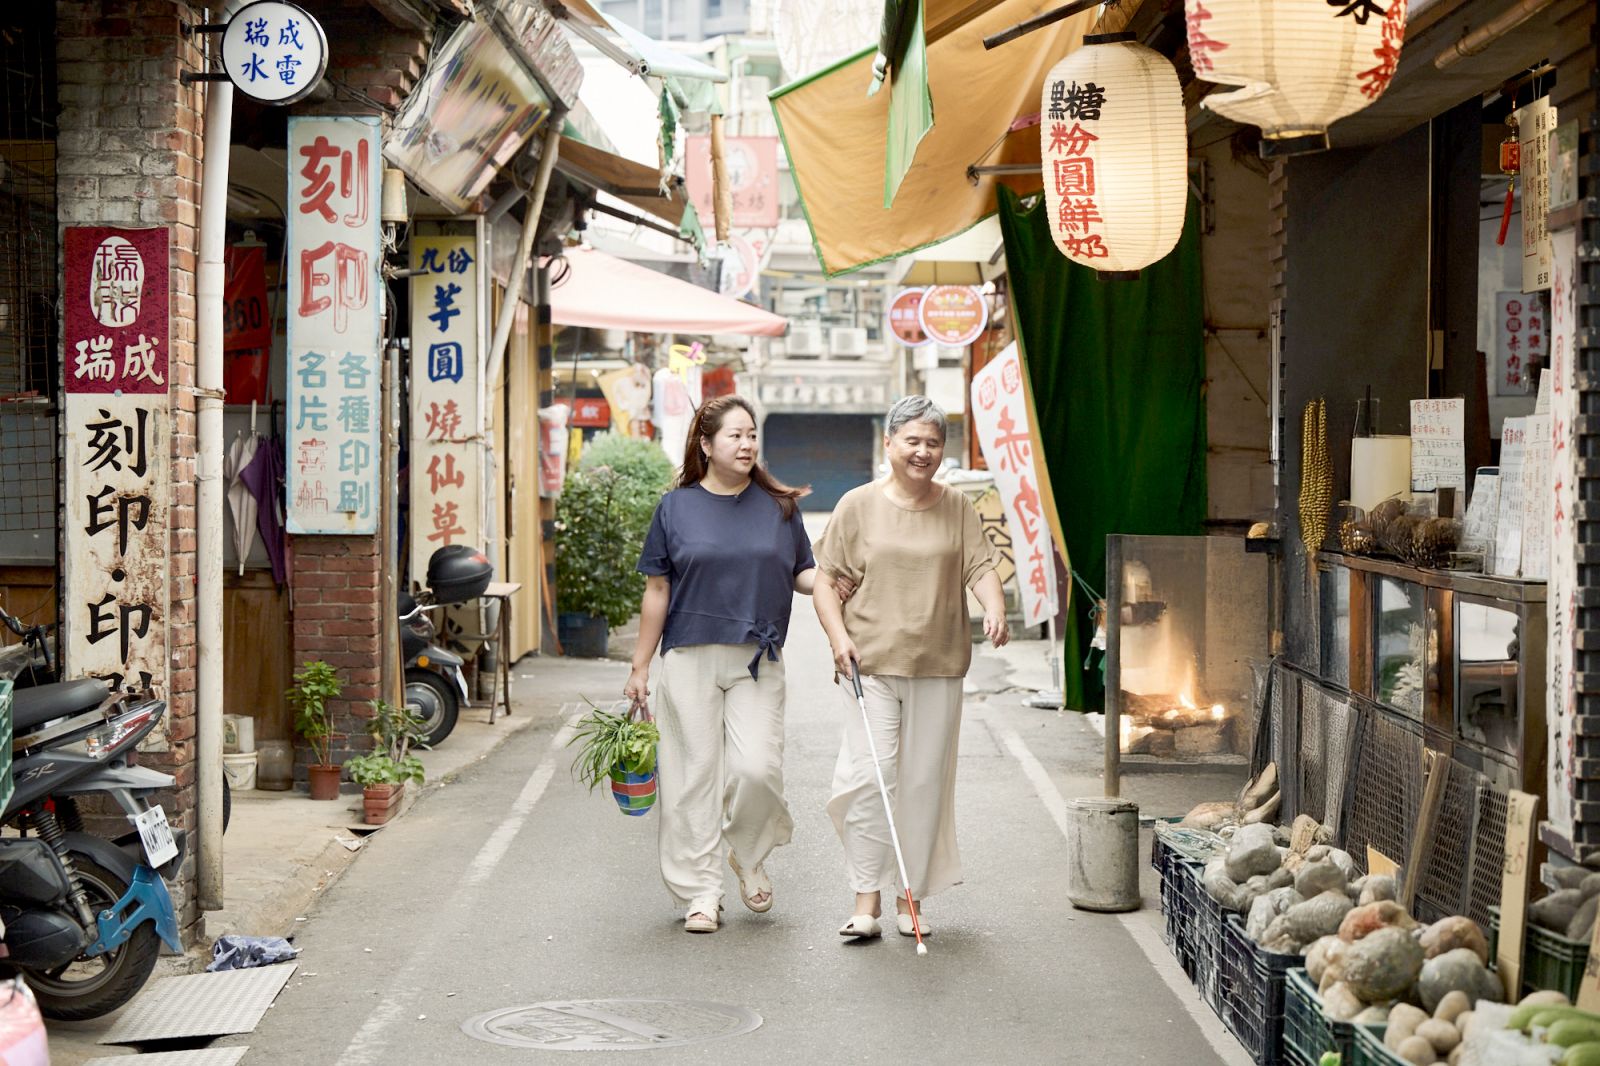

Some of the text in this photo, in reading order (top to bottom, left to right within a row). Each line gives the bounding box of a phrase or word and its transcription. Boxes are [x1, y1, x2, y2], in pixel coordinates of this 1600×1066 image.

[241, 52, 302, 85] 水電
[244, 17, 304, 50] 瑞成
[1049, 80, 1107, 121] 黑糖
[1049, 121, 1109, 259] 粉圓鮮奶
[298, 136, 369, 334] 刻印
[420, 247, 475, 275] 九份
[73, 333, 165, 386] 瑞成
[427, 282, 464, 384] 芋圓
[336, 351, 371, 519] 各種印刷
[425, 398, 466, 548] 燒仙草
